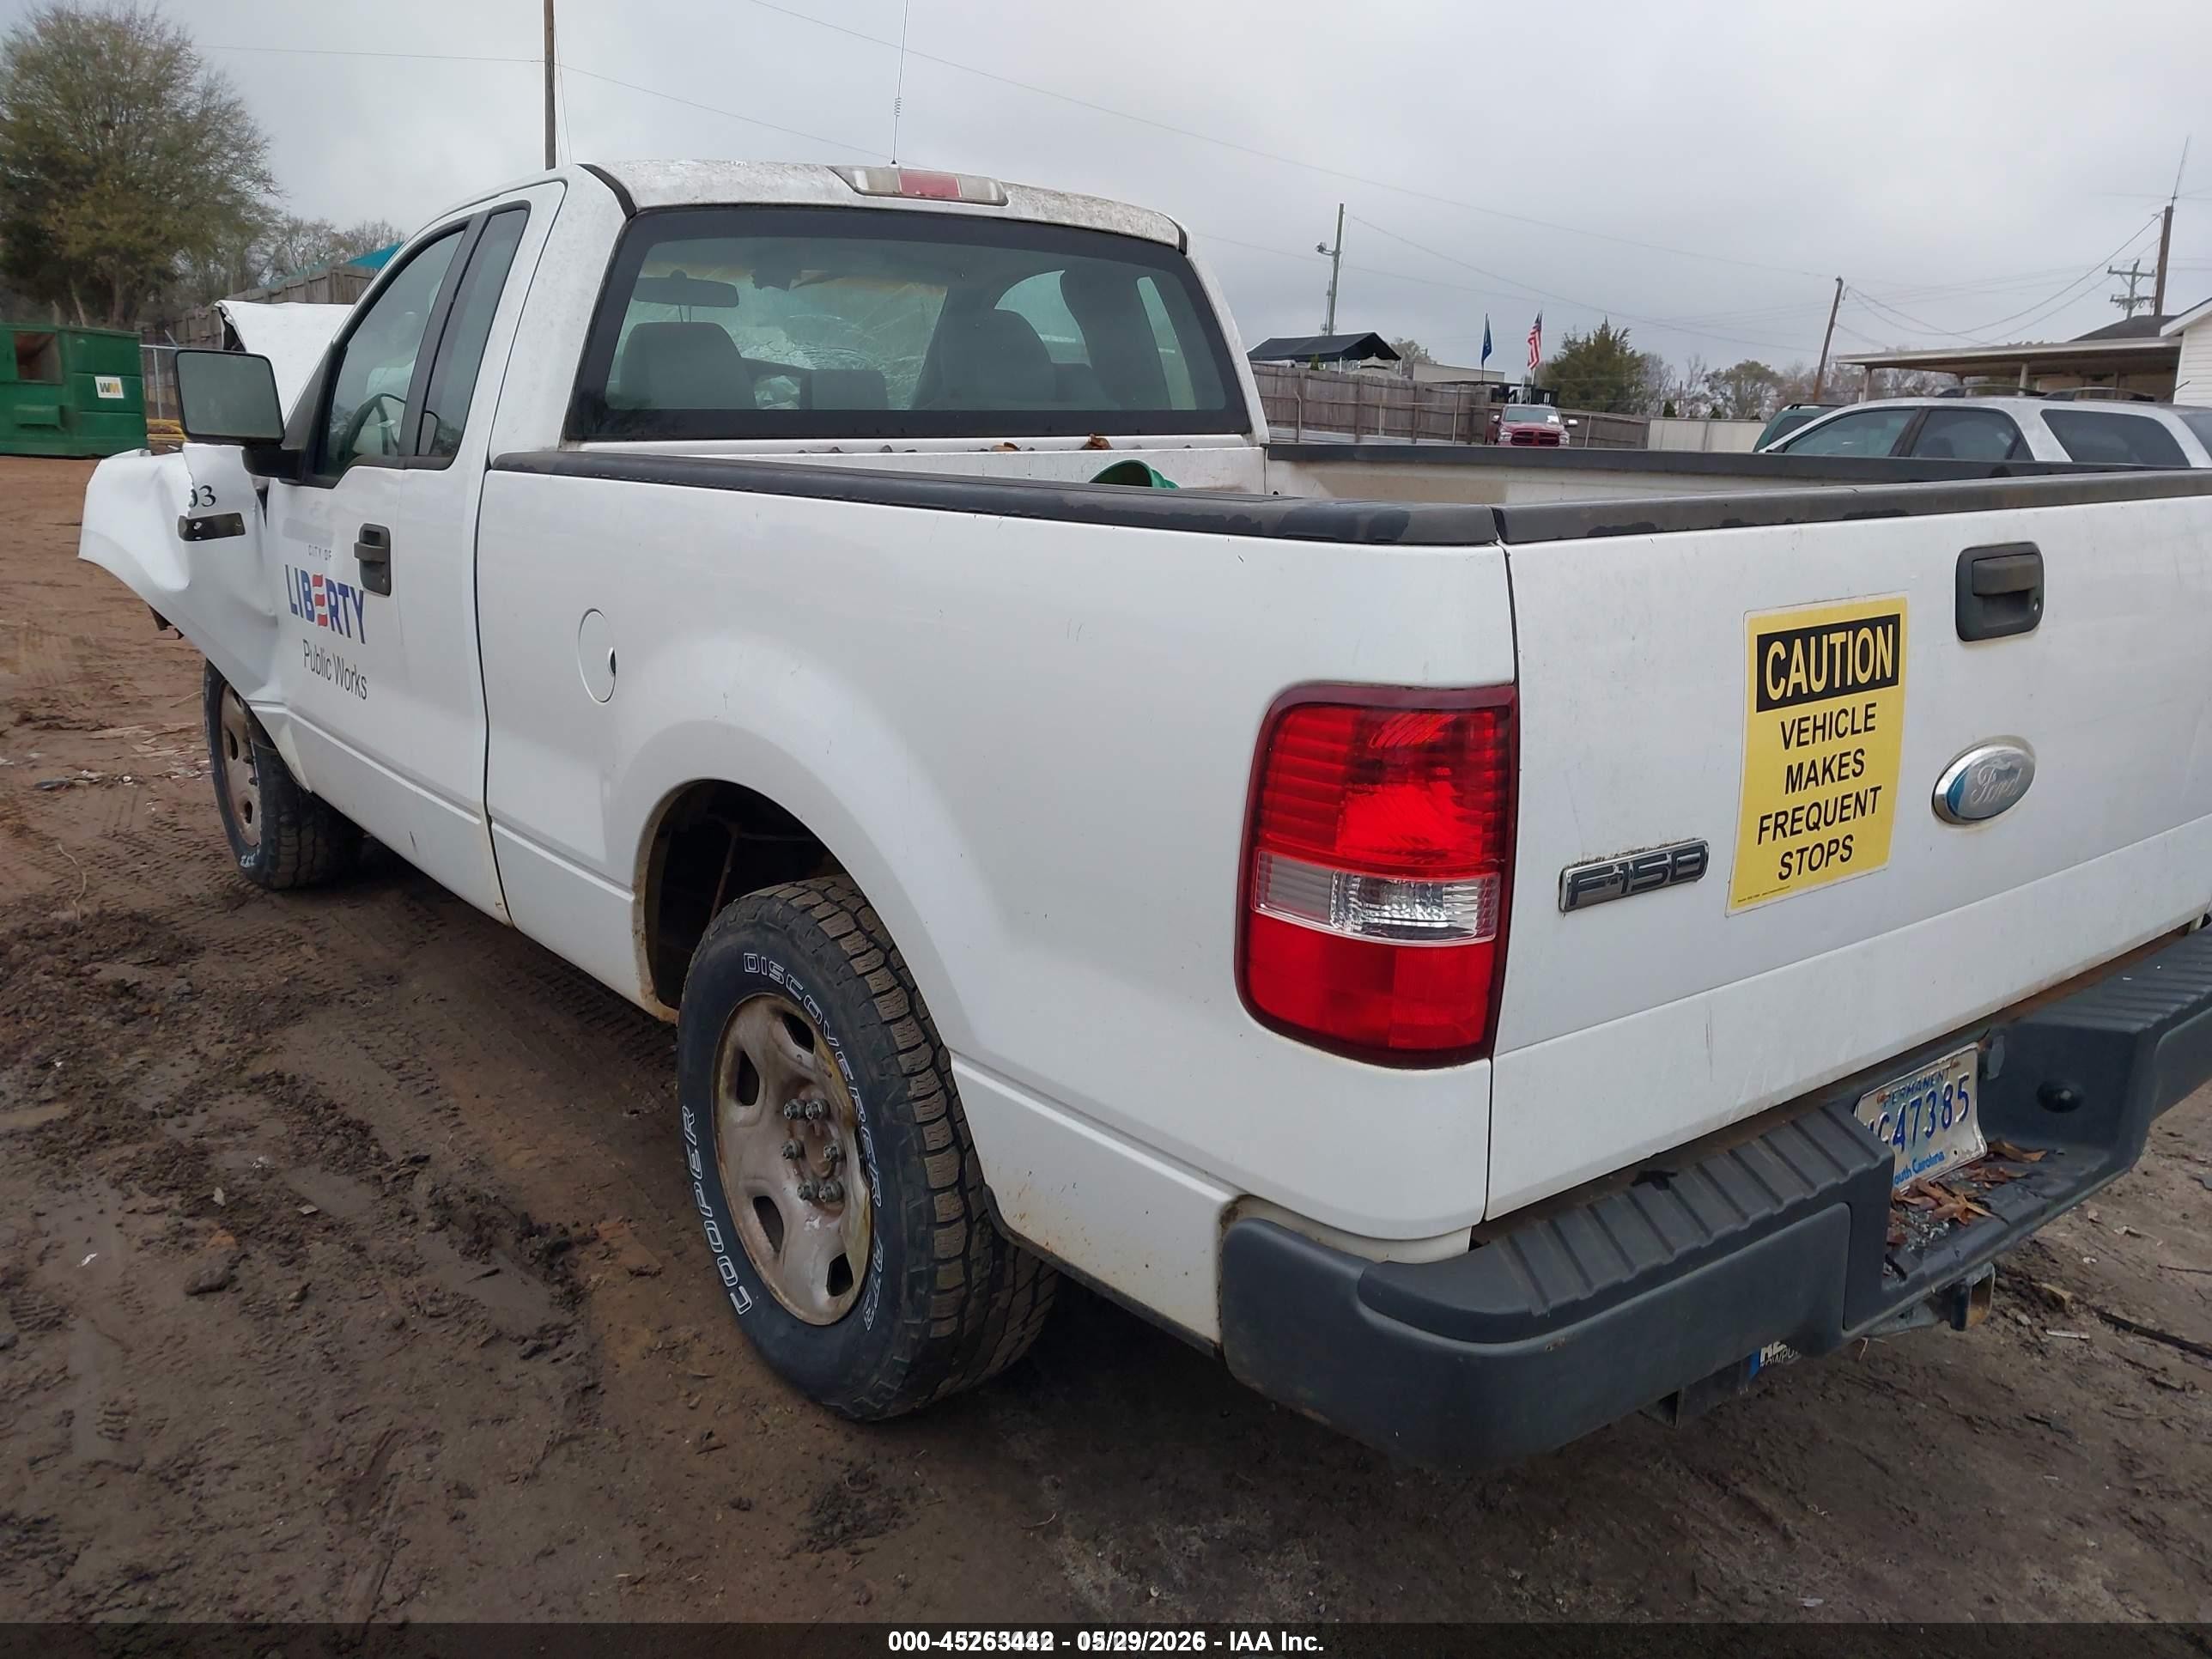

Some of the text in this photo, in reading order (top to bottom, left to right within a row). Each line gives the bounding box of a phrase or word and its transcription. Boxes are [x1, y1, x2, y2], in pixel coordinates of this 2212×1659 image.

[100, 382, 119, 393] WM
[285, 564, 366, 644] LIBERTY
[302, 639, 368, 700] Public Works
[1765, 624, 1893, 701] CAUTION
[1780, 702, 1877, 750] VEHICLE
[1784, 748, 1865, 794] MAKES
[1757, 786, 1882, 845] FREQUENT
[1778, 834, 1854, 881] STOPS
[743, 952, 882, 1208] DISCOVERER
[1893, 1151, 1945, 1186] outh Carolina
[682, 1106, 752, 1316] COOPER
